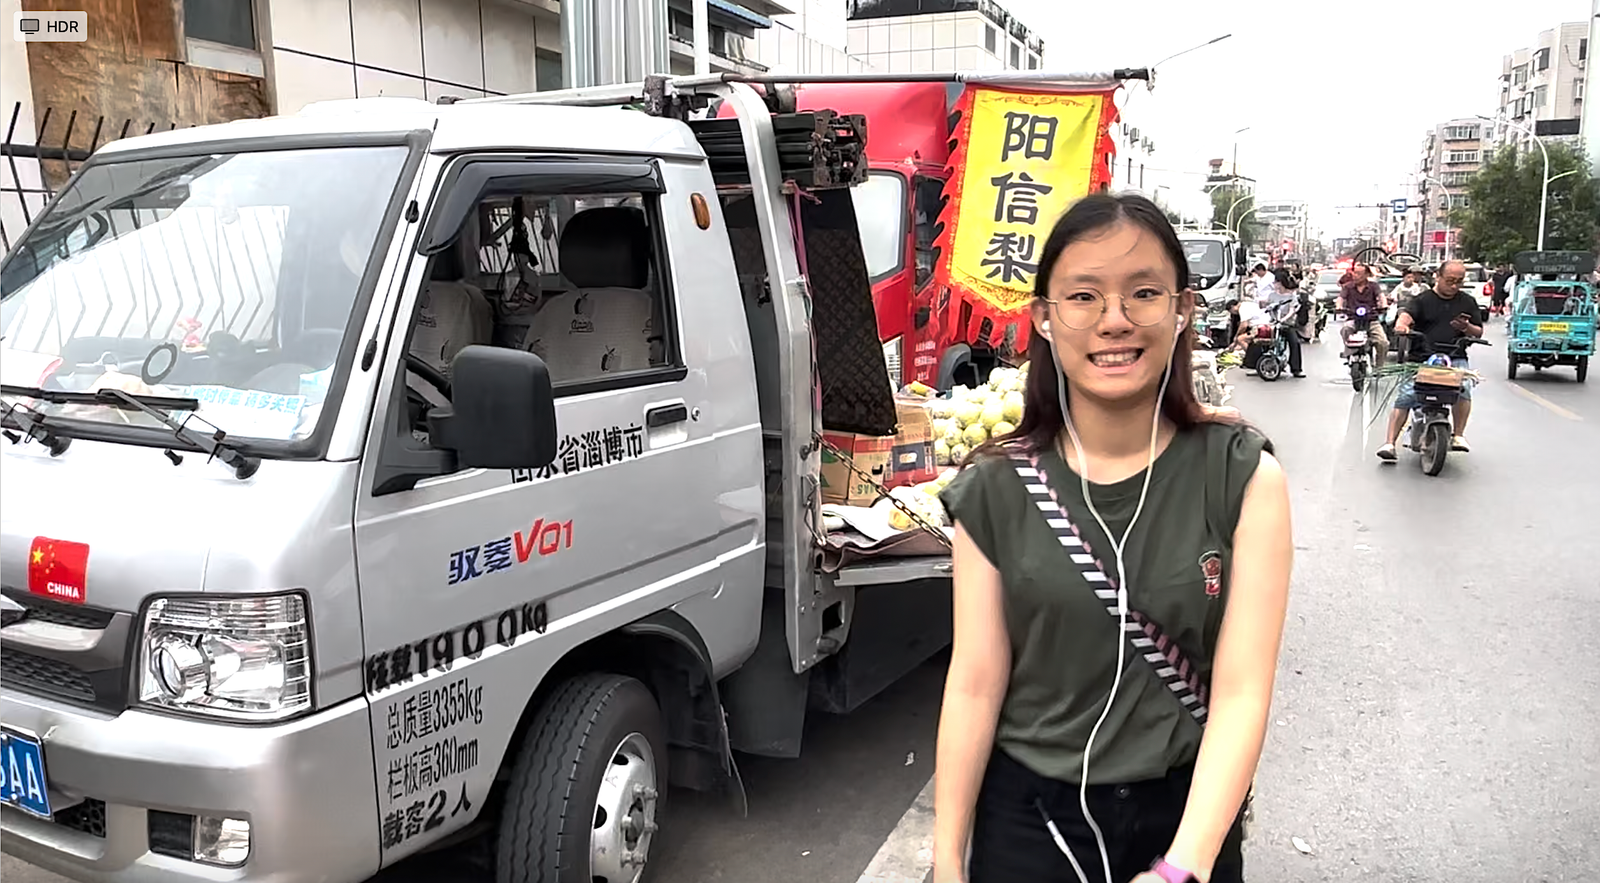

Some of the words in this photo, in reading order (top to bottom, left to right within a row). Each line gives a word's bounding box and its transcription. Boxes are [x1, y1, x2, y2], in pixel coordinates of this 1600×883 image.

[979, 111, 1058, 284] 阳信梨
[46, 581, 80, 600] CHINA
[386, 677, 484, 750] 总质量3355kg
[387, 735, 479, 805] 栏板高360mm
